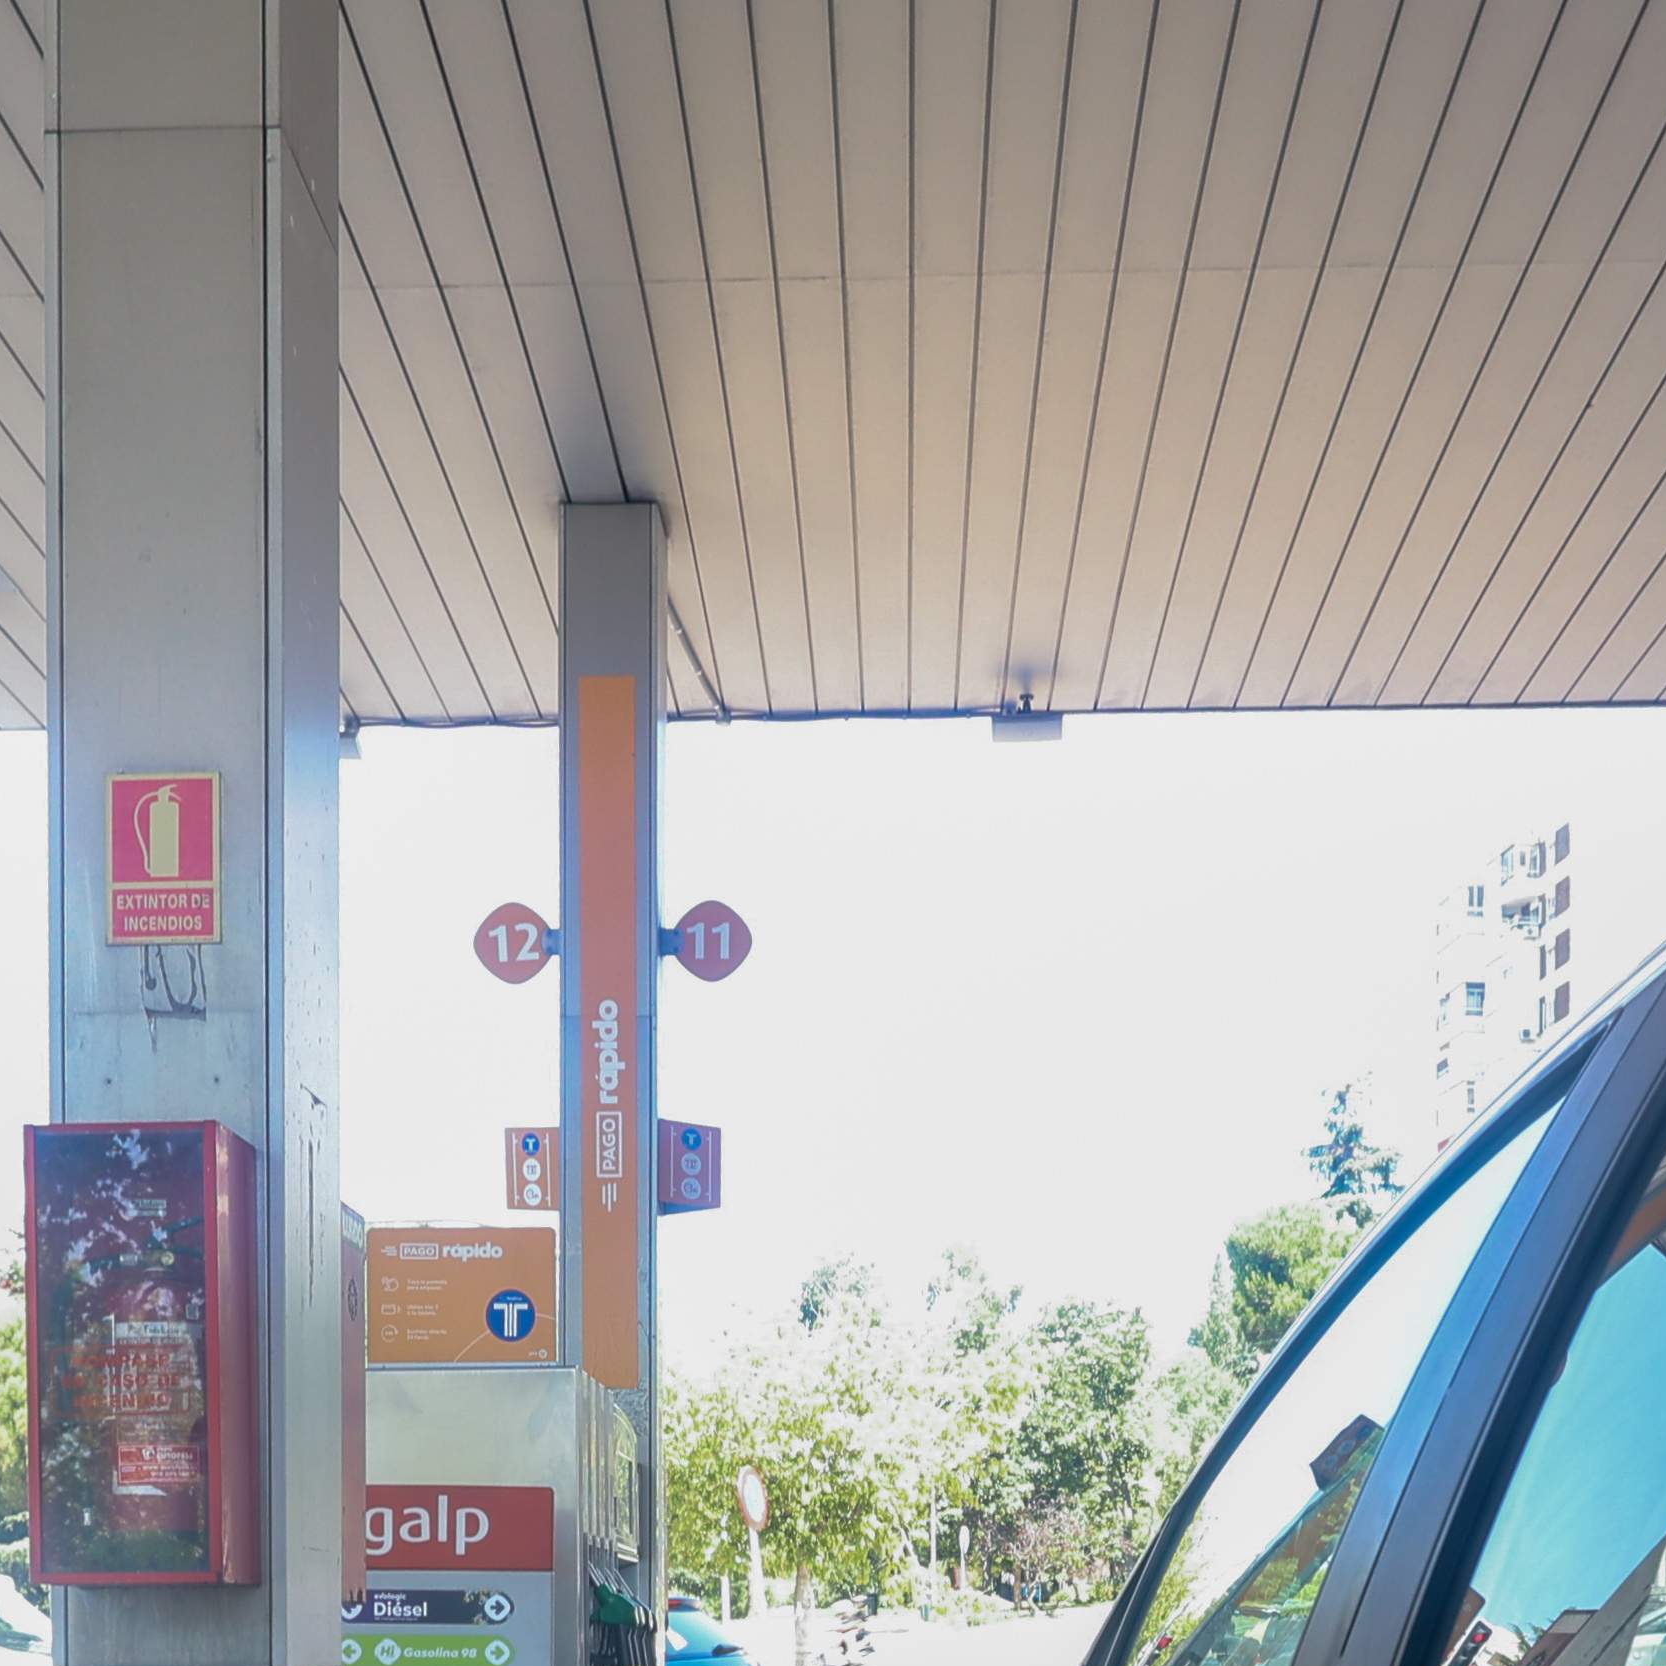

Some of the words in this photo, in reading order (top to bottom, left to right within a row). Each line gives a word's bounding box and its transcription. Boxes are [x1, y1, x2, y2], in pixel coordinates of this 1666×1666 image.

[116, 893, 186, 910] EXTINTOR
[191, 894, 210, 909] DE
[124, 915, 202, 931] INCENDIOS
[488, 922, 540, 963] 12
[686, 922, 731, 960] 11
[591, 999, 625, 1105] rápido
[602, 1118, 616, 1171] PAGO
[403, 1246, 435, 1257] PAGO
[442, 1241, 503, 1263] rápido
[365, 1495, 489, 1556] galp
[374, 1592, 406, 1601] evologic
[373, 1601, 428, 1617] Diésel
[403, 1647, 459, 1658] Gasolina
[461, 1648, 477, 1658] 98
